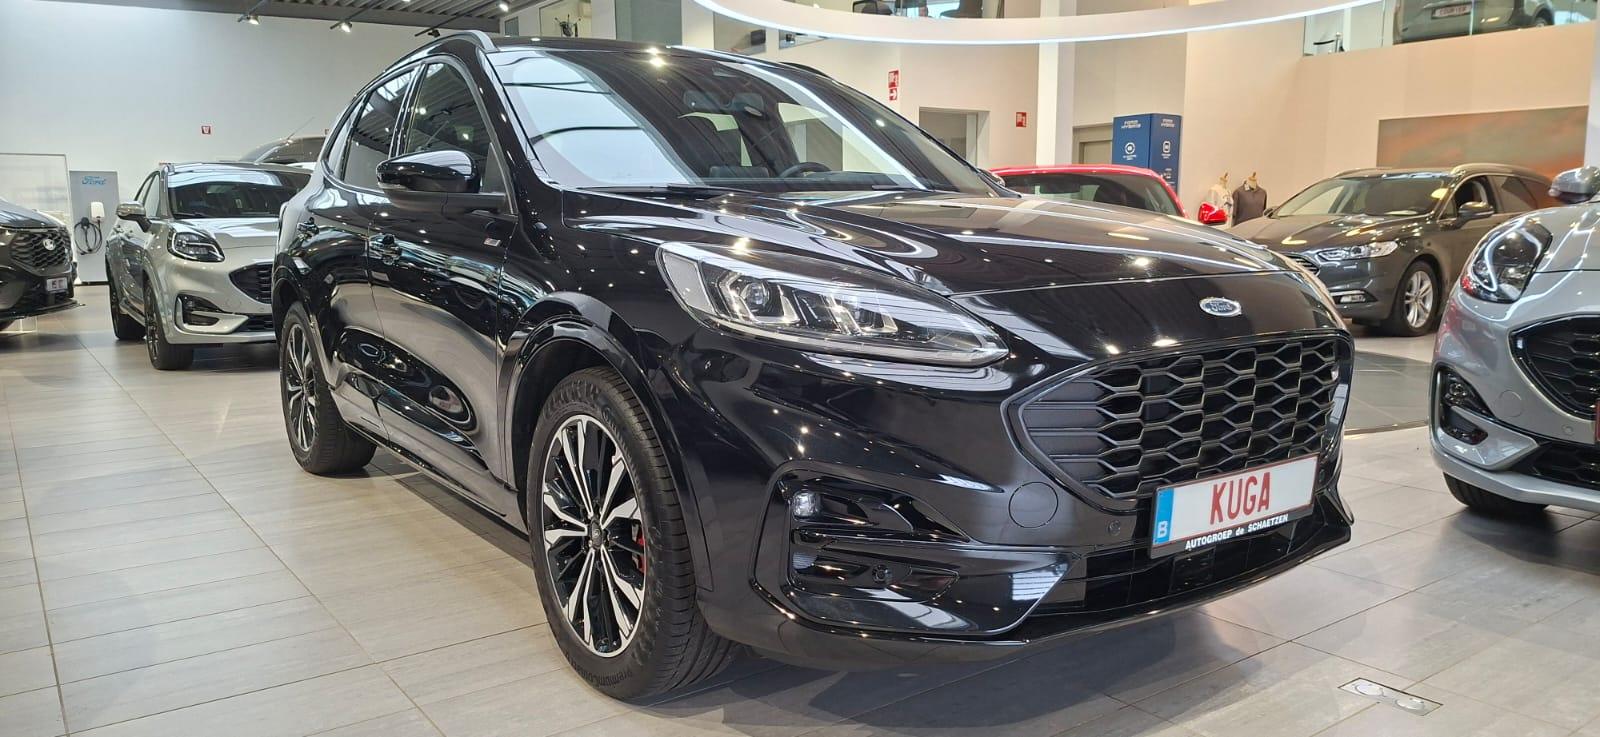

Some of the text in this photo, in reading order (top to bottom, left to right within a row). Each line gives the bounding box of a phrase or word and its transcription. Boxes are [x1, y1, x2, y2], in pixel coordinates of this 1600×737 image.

[1210, 472, 1270, 525] KUGA
[1157, 520, 1169, 539] B
[1185, 514, 1289, 550] AUTOGROEP de SCHAETZEN
